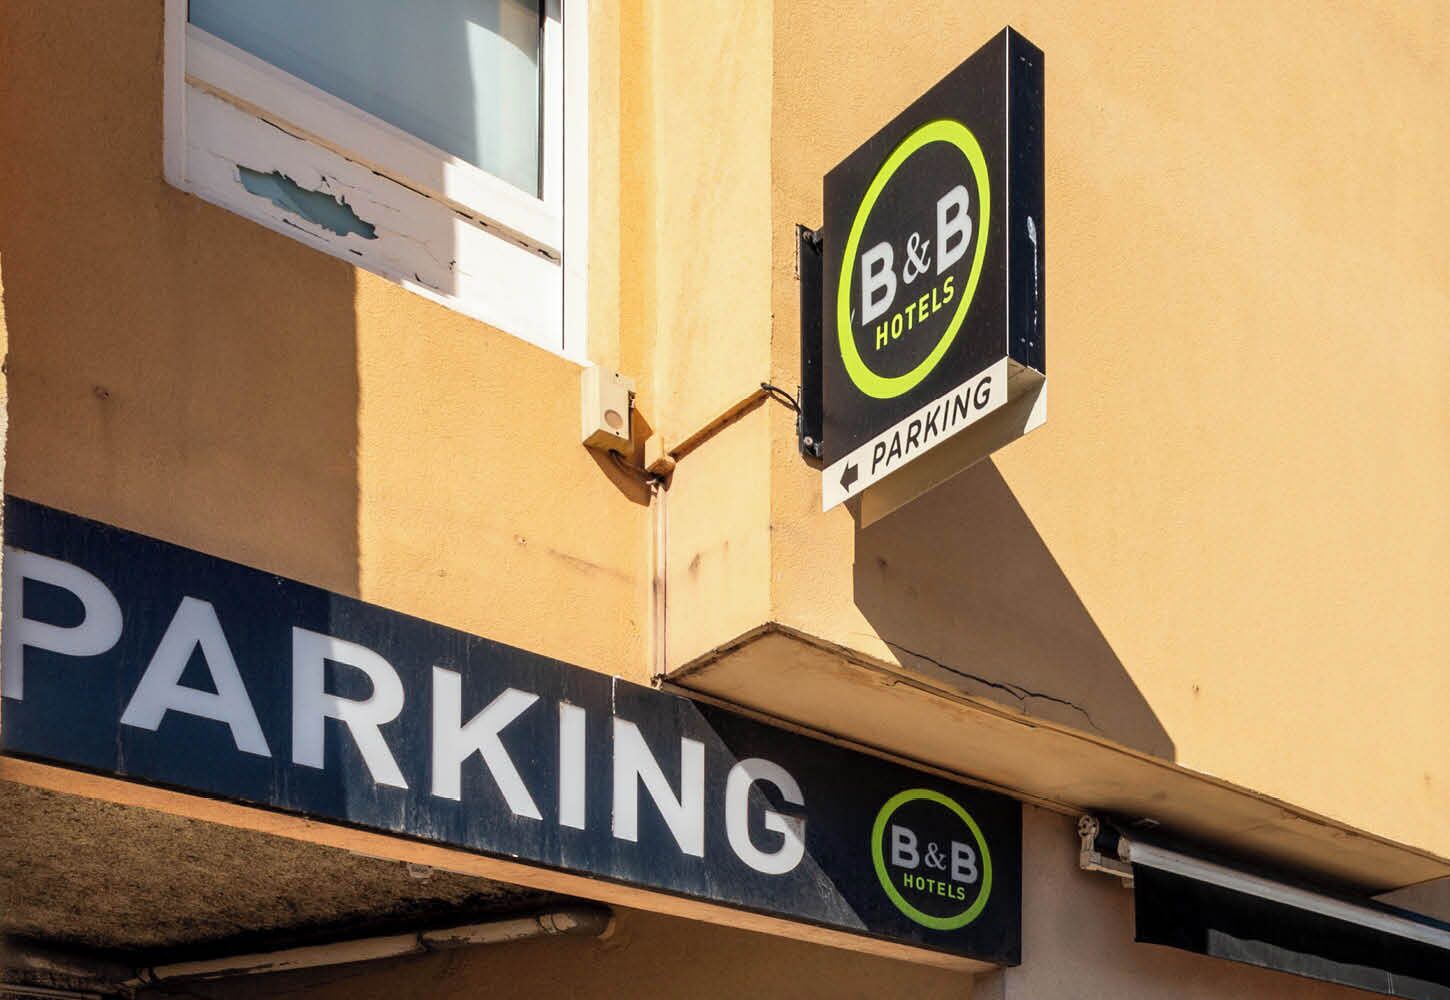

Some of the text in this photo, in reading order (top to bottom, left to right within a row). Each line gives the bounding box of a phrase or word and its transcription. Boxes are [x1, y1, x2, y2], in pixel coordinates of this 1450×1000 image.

[861, 184, 973, 327] B&B
[875, 275, 955, 351] HOTELS
[871, 376, 992, 476] PARKING
[2, 545, 806, 876] PARKING
[891, 823, 978, 884] B&B
[903, 872, 966, 901] HOTELS
